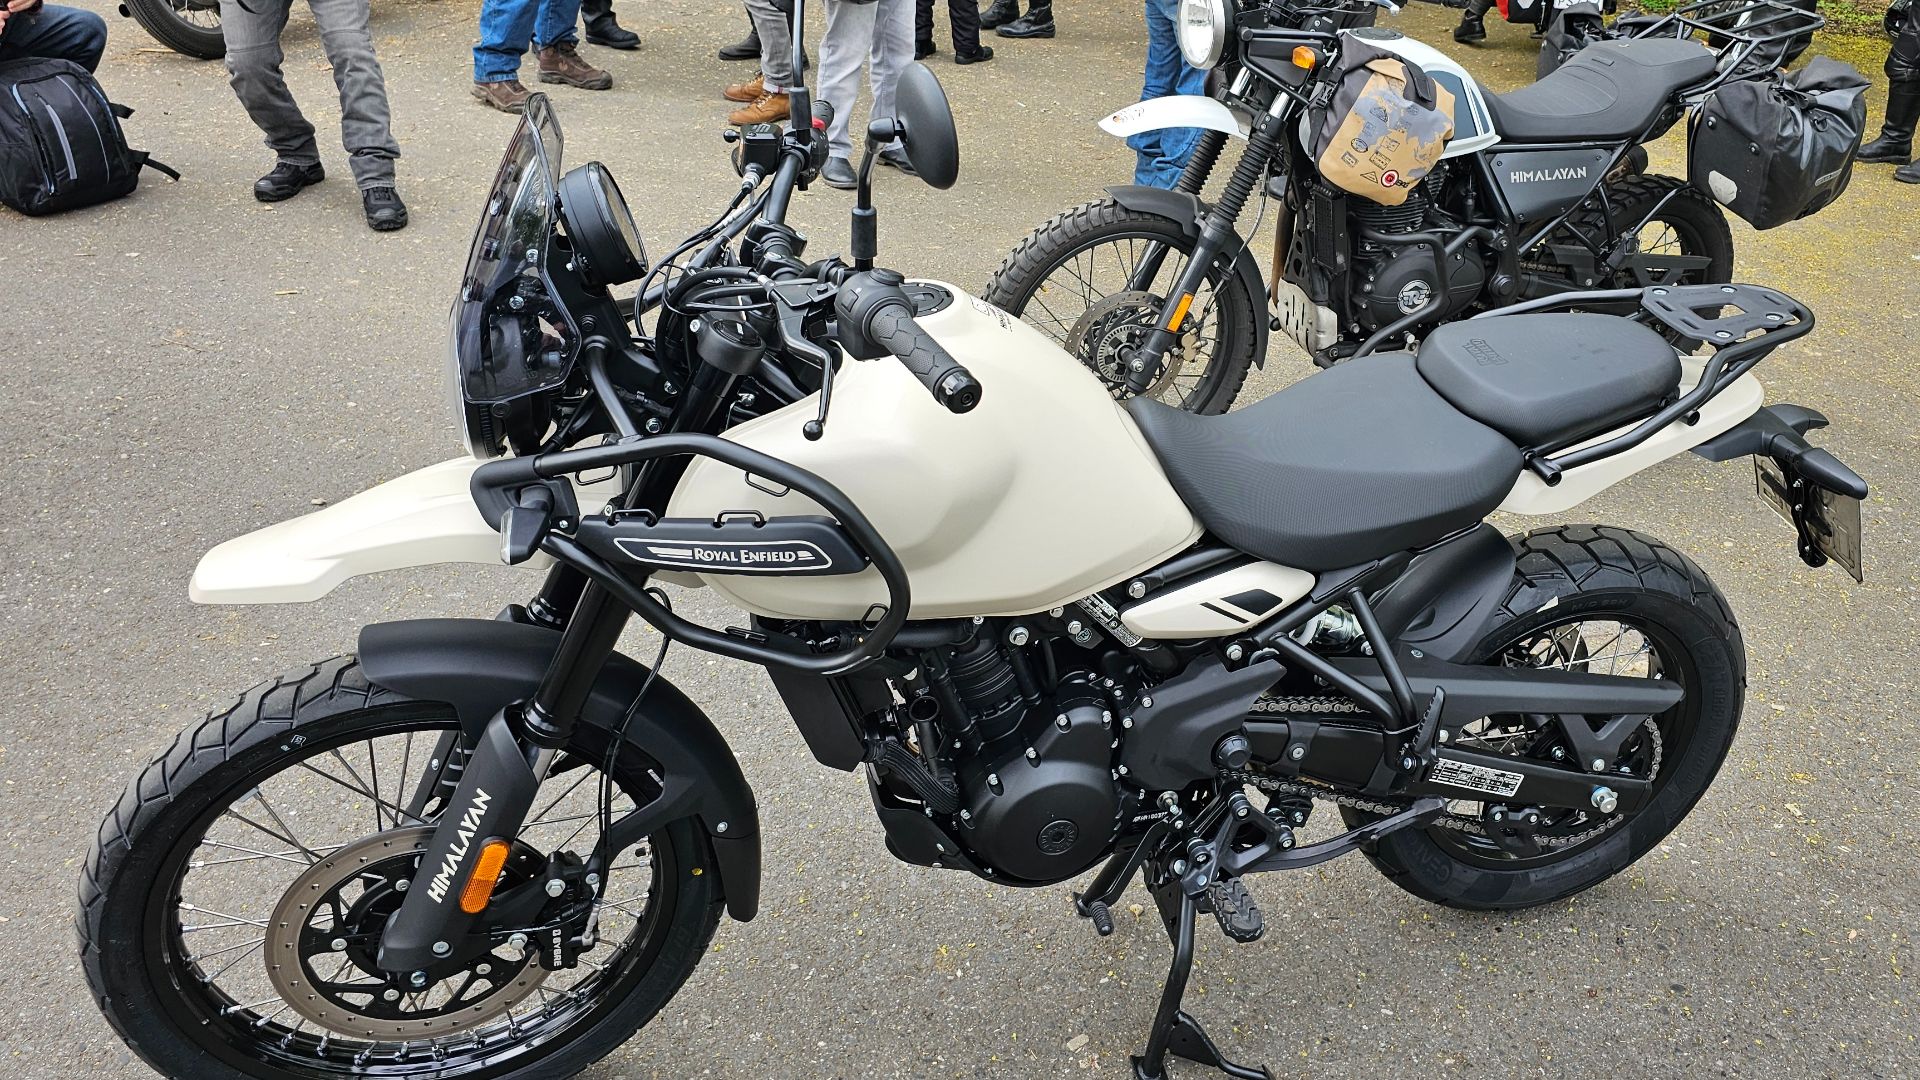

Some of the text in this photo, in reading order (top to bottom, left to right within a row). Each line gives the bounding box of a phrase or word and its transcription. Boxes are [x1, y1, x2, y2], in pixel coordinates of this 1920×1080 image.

[1510, 166, 1587, 184] HIMALAYAN
[693, 547, 796, 563] ROYAL ENFIELD
[427, 787, 492, 904] HIMALAYAN
[552, 937, 562, 967] BYBRE
